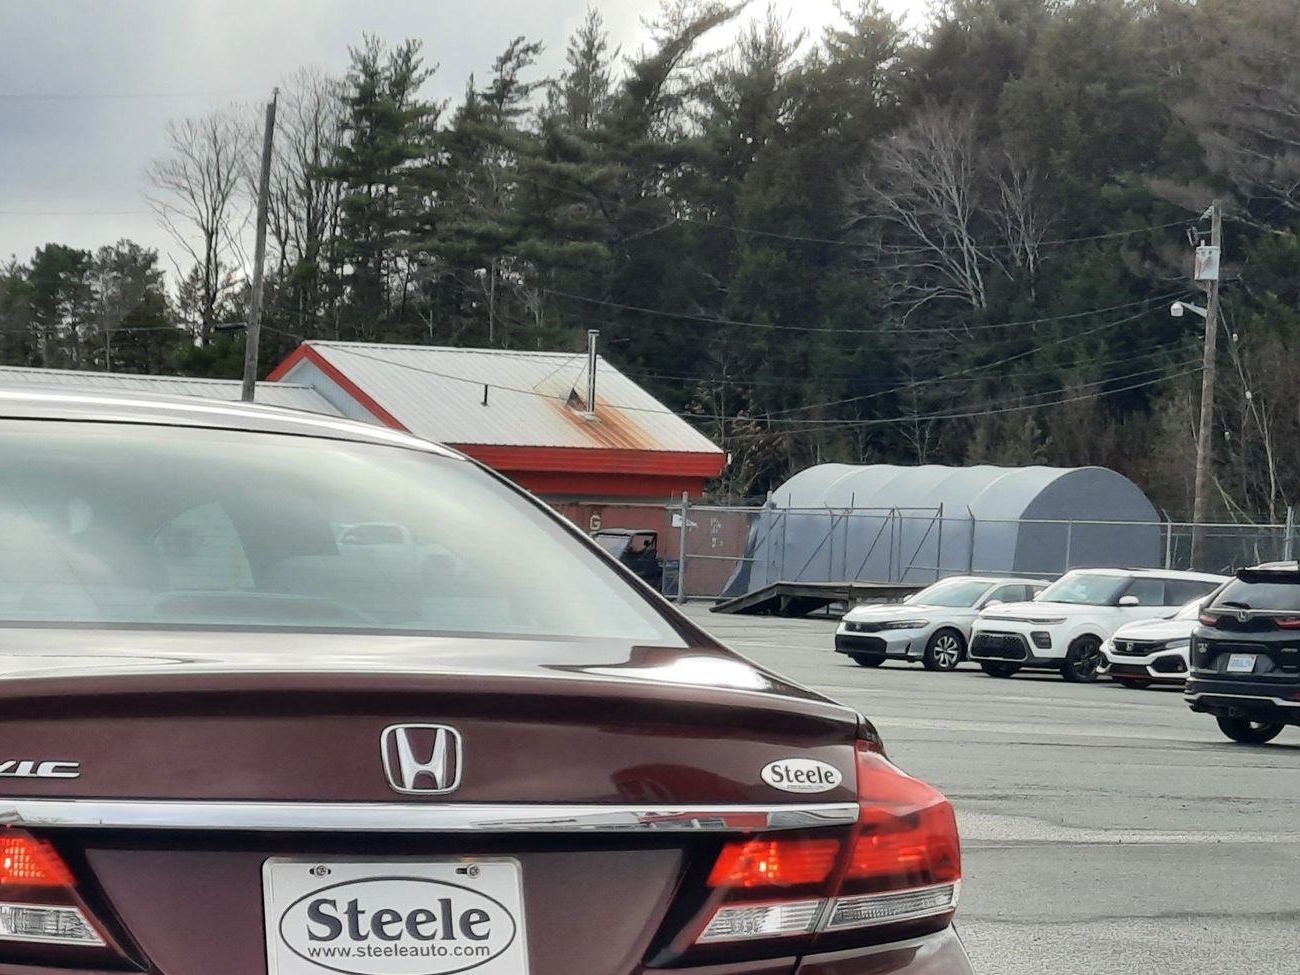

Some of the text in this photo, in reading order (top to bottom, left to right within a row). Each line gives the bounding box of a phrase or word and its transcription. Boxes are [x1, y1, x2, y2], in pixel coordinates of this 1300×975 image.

[770, 764, 835, 785] Steele
[306, 897, 491, 942] Steele
[307, 943, 491, 958] www.steeleauto.com
